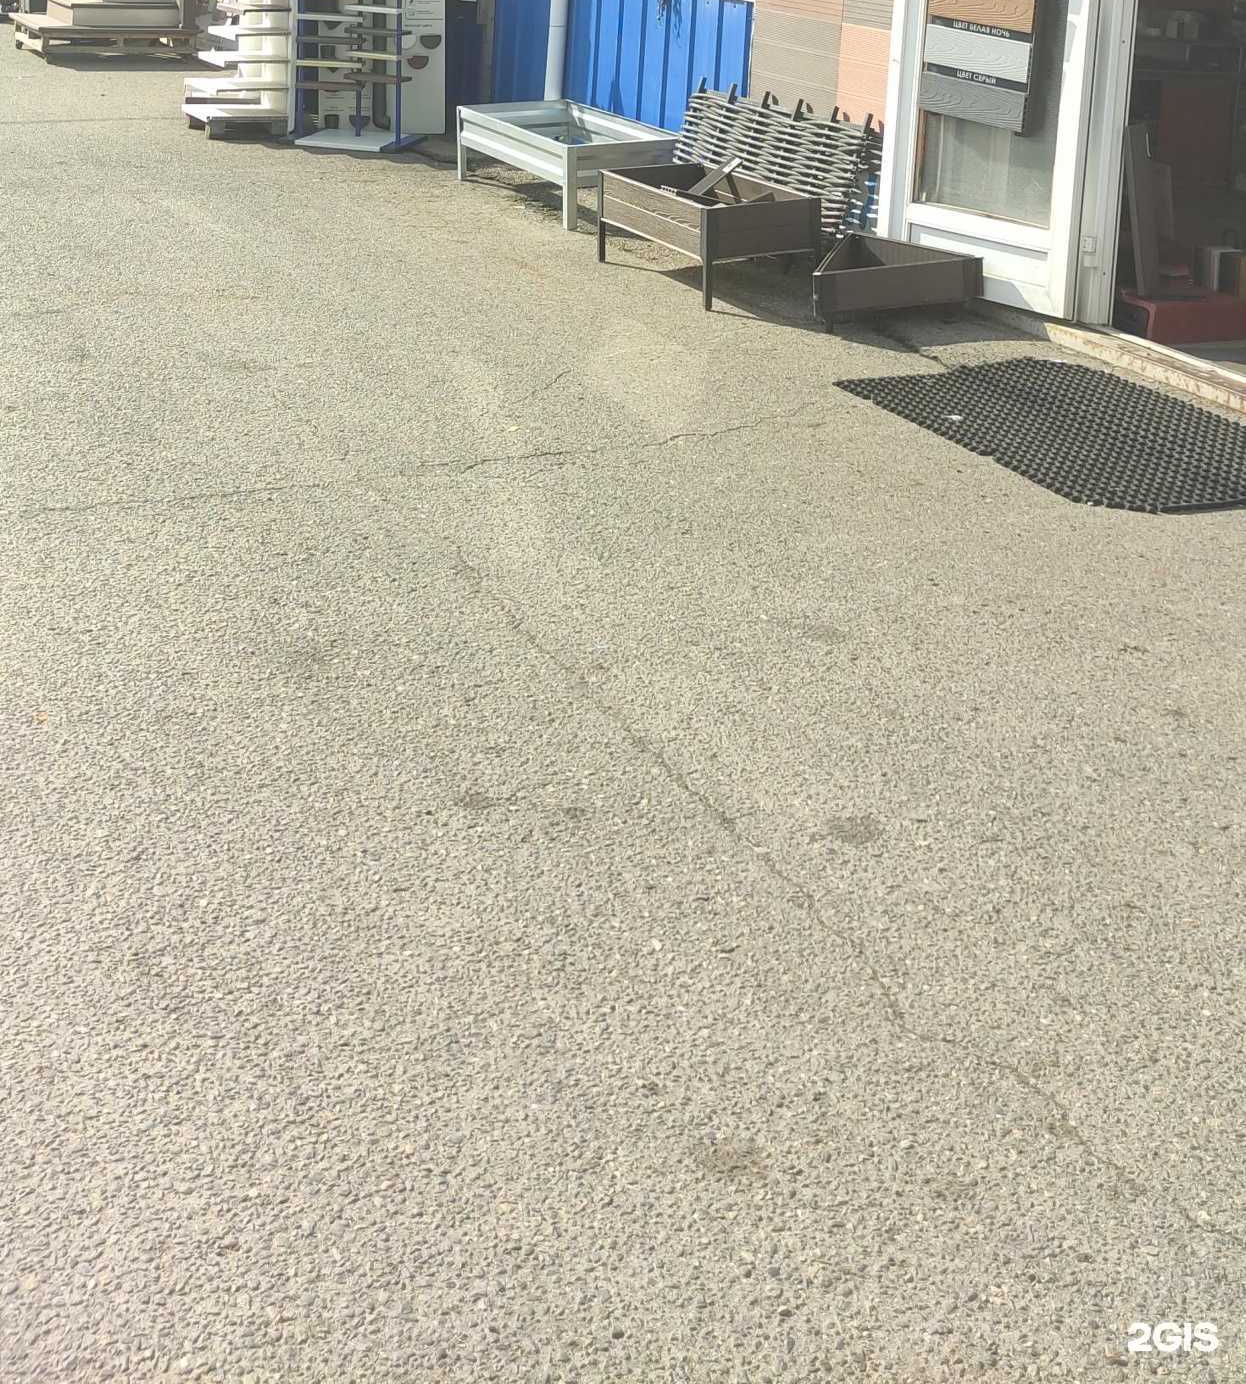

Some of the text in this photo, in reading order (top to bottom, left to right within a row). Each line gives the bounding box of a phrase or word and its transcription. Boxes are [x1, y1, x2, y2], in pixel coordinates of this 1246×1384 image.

[953, 20, 1010, 38] ЦВЕТ БЕЛАЯ НОЧЬ
[956, 70, 997, 84] ЦВЕТ СЕРЫЙ
